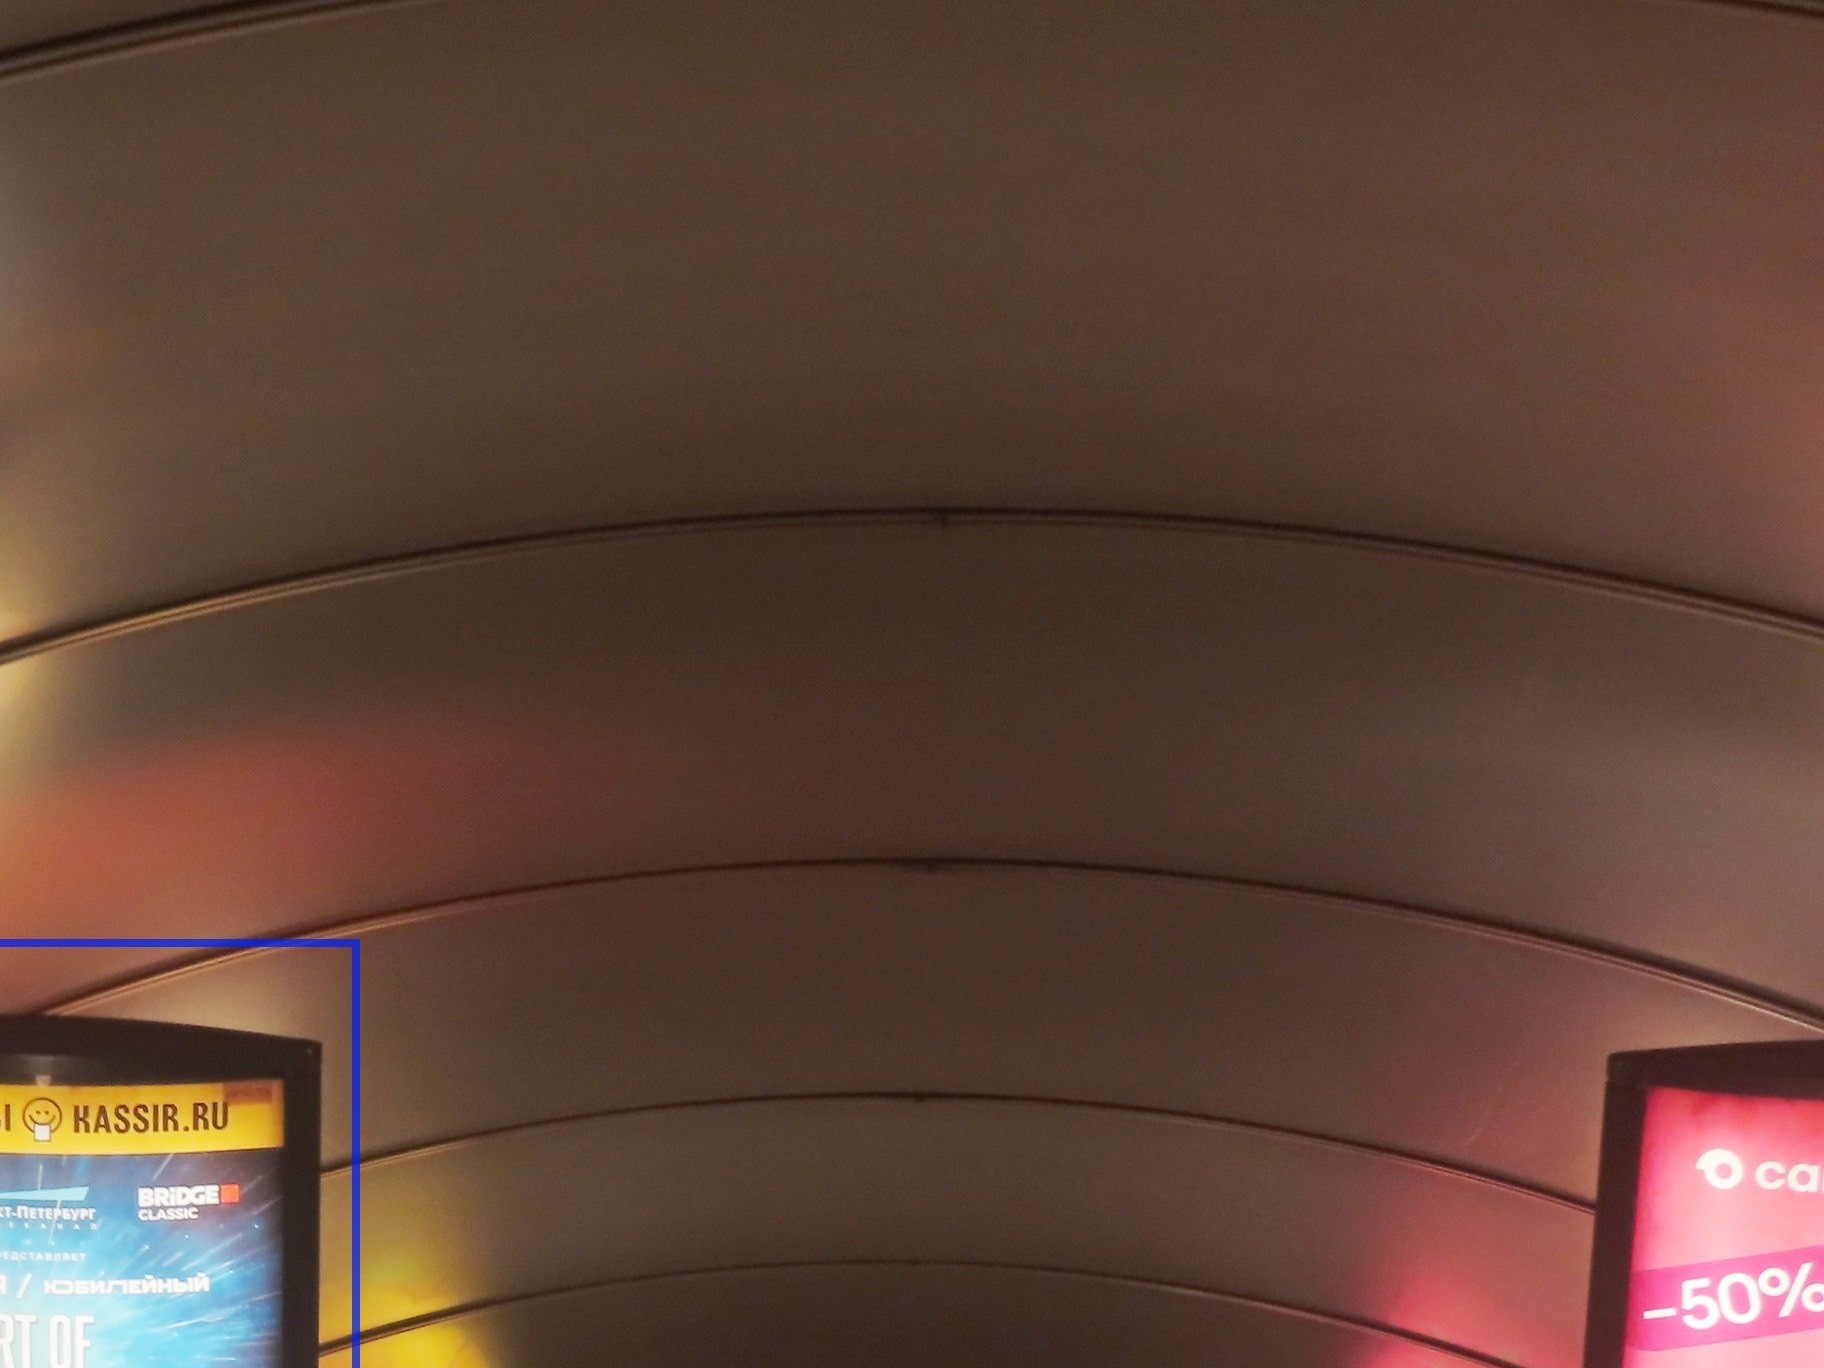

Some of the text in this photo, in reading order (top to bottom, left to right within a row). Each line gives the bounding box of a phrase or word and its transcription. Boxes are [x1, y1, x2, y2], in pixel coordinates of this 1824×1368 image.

[73, 1101, 229, 1134] KASSIR.RU
[1755, 1160, 1824, 1193] са
[138, 1207, 199, 1222] CLASSIC
[44, 1271, 210, 1295] ЮБИЛЕЙНЫЙ
